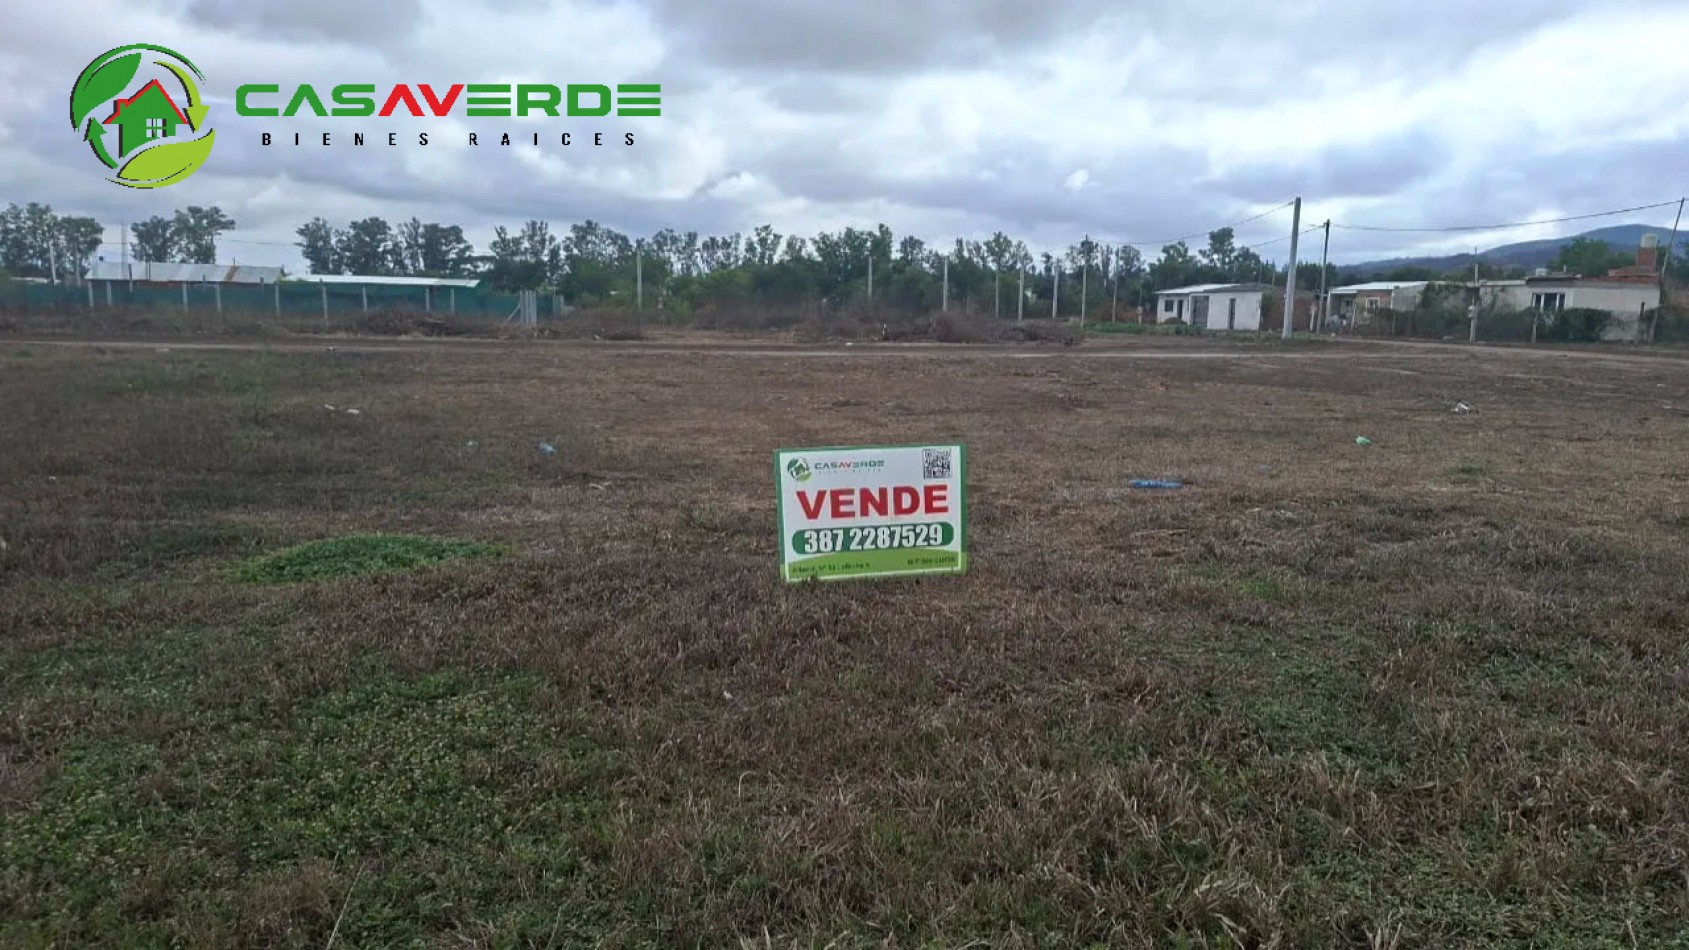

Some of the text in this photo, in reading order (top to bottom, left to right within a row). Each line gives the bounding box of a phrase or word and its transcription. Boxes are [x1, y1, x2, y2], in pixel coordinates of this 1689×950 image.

[813, 459, 885, 470] CASAVERDE
[796, 484, 949, 520] VENDE
[804, 524, 943, 553] 387 2287529
